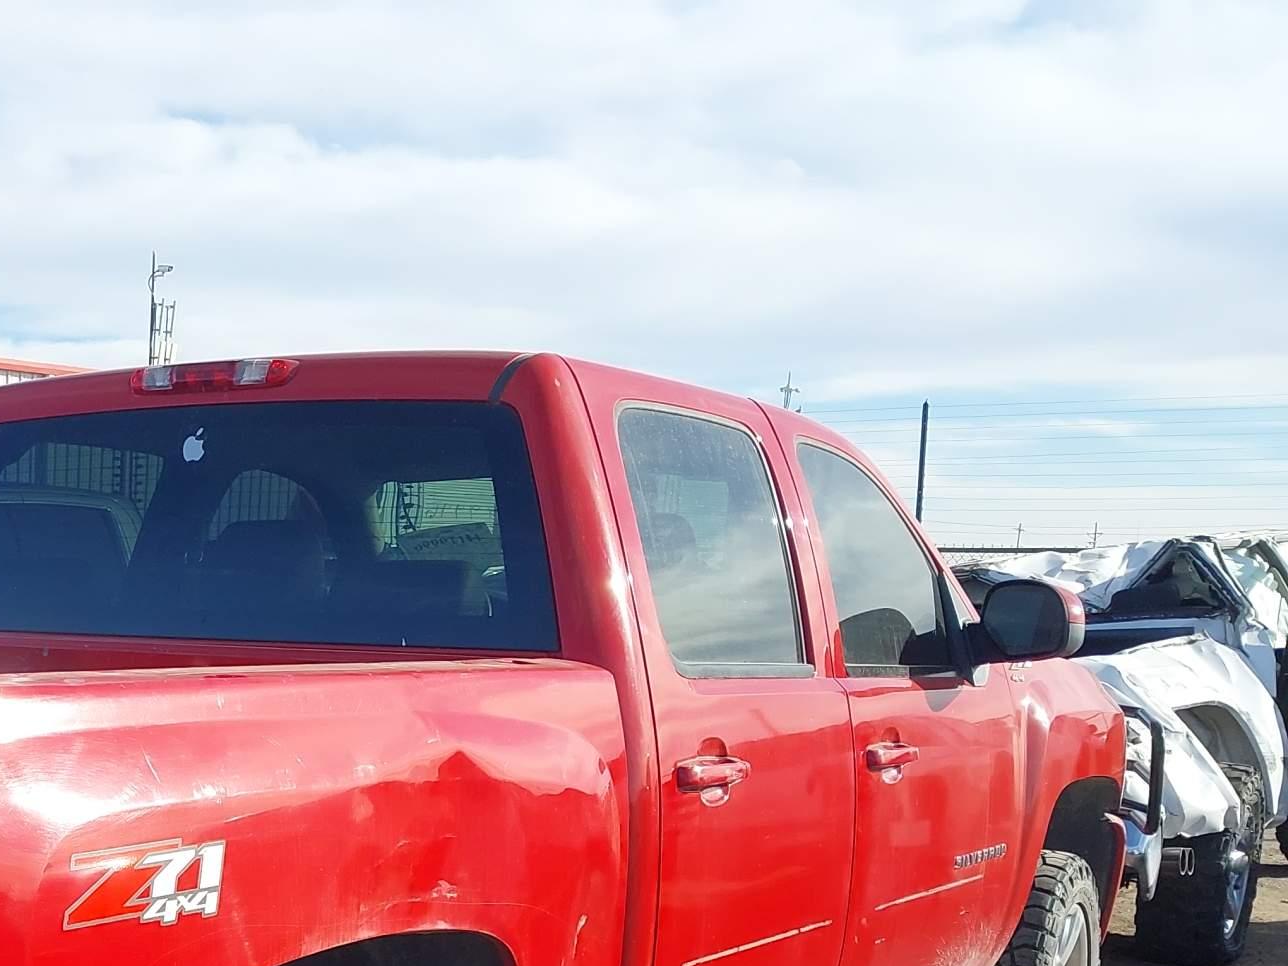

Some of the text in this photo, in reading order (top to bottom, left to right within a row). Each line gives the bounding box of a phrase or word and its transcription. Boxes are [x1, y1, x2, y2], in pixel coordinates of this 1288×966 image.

[953, 842, 1008, 869] SILVERADO
[63, 837, 226, 931] Z71
[140, 890, 219, 926] 4x4
